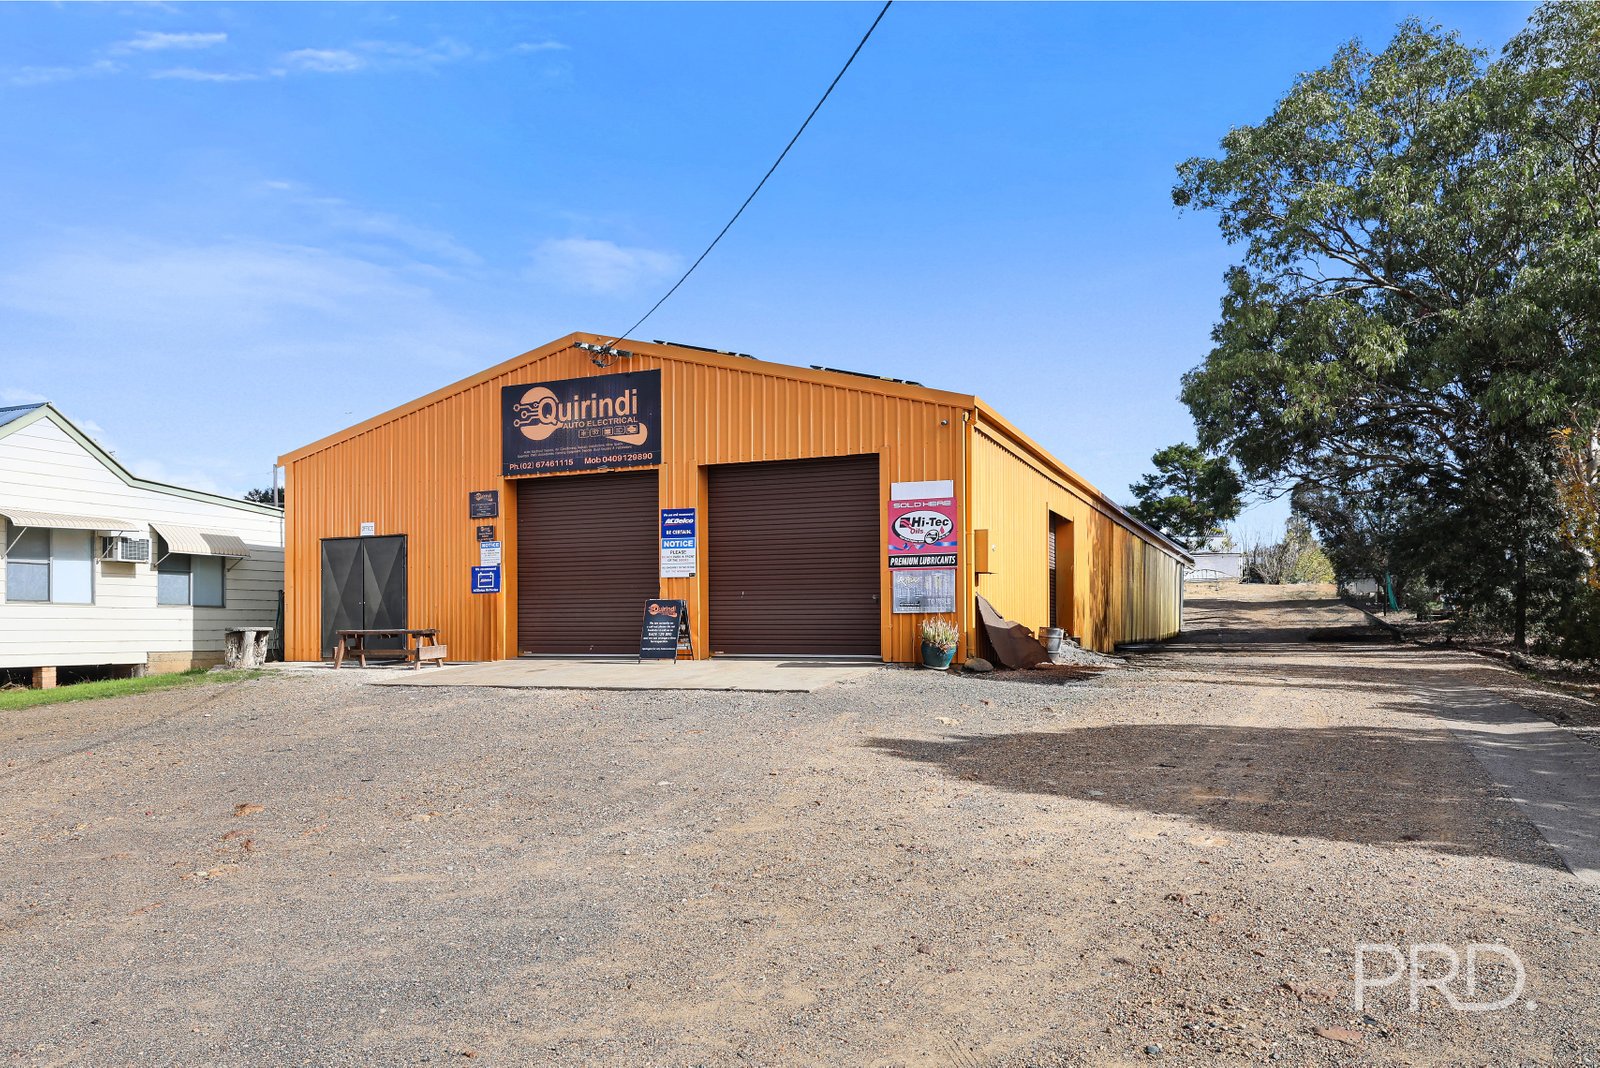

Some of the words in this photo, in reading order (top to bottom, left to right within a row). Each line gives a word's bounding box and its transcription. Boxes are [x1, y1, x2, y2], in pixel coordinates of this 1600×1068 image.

[537, 388, 638, 425] Quirindi
[563, 420, 586, 429] AUTO
[586, 416, 638, 428] ELECTRICAL
[535, 458, 574, 469] 67461115
[584, 455, 602, 465] Mob
[602, 452, 653, 463] 0409129890
[911, 516, 950, 528] Hi-Tec
[910, 527, 924, 535] Oils
[663, 539, 694, 548] NOTICE
[890, 557, 918, 566] PREMIUM
[919, 556, 956, 565] LUBRICANTS
